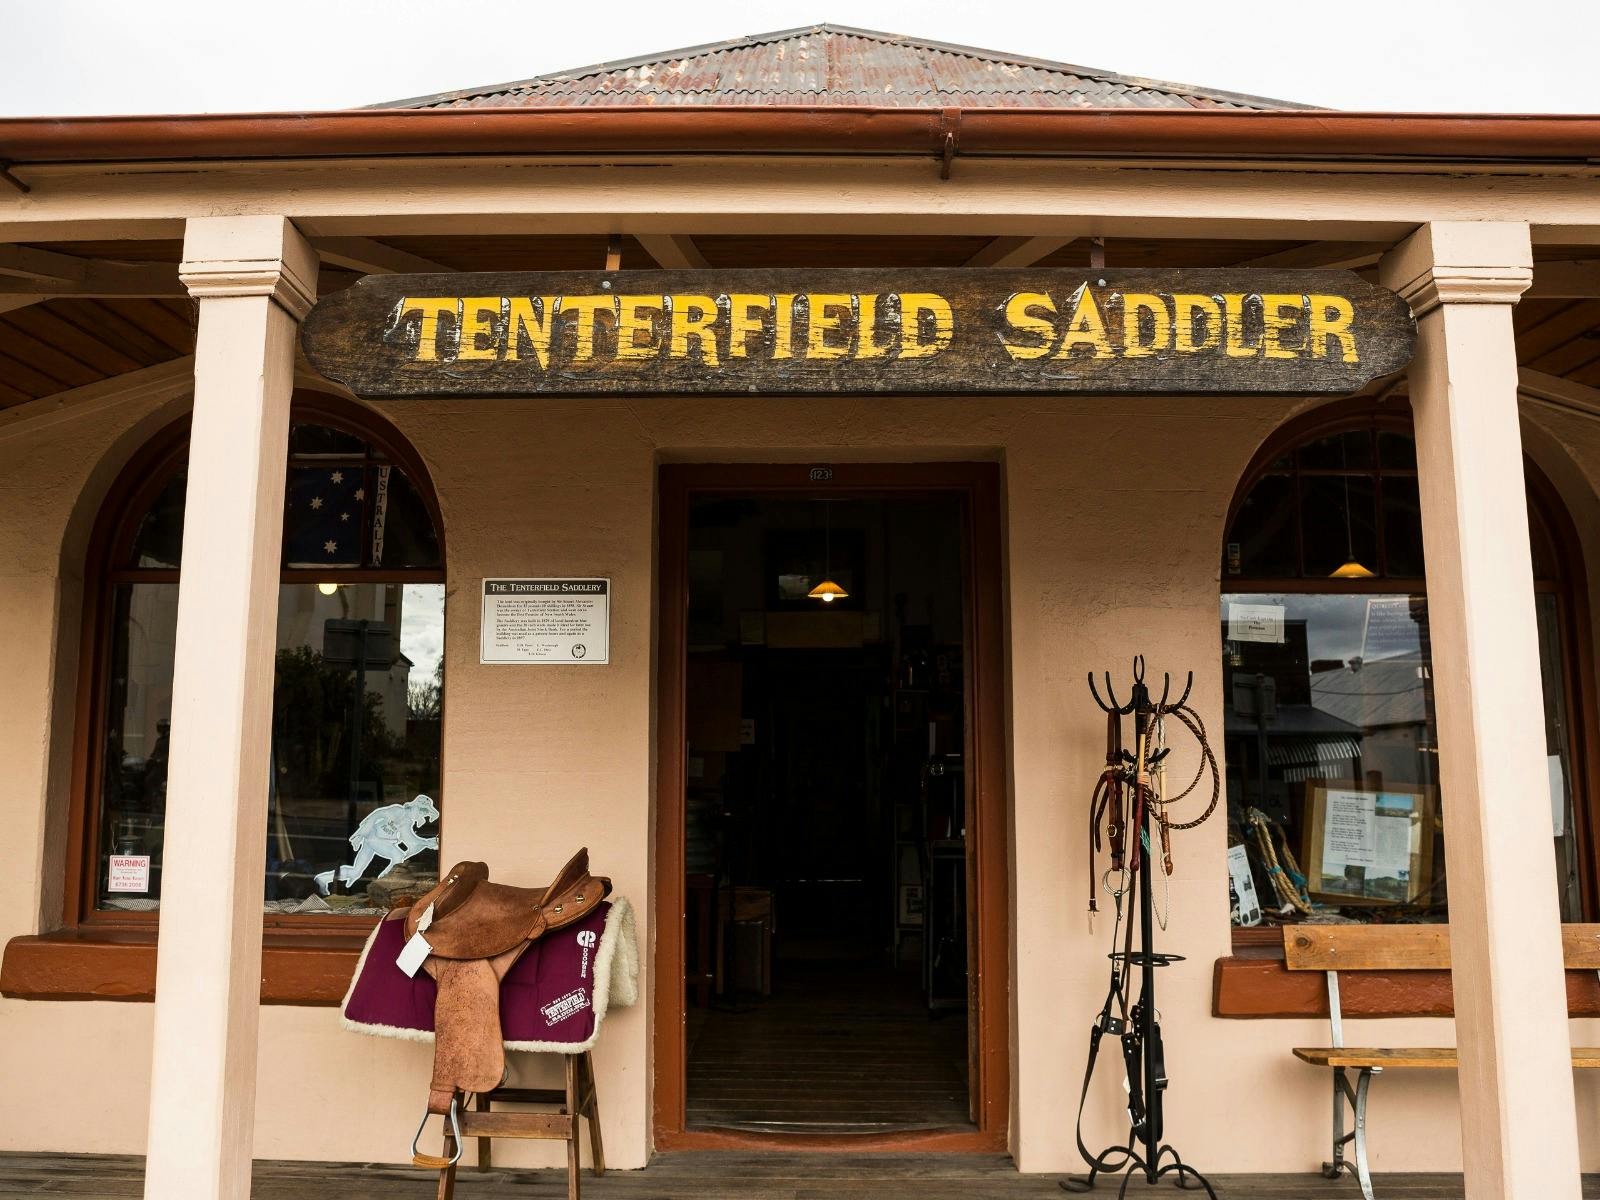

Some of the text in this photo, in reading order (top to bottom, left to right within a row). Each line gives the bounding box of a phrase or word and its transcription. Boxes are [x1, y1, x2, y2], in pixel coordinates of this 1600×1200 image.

[394, 282, 1359, 369] TENTERFIELD SADDLER
[813, 470, 829, 480] 123
[491, 583, 601, 592] THE TENTERFIELD SADDLERY
[114, 859, 146, 867] WARNING
[545, 993, 585, 1019] TENTERFIELD
